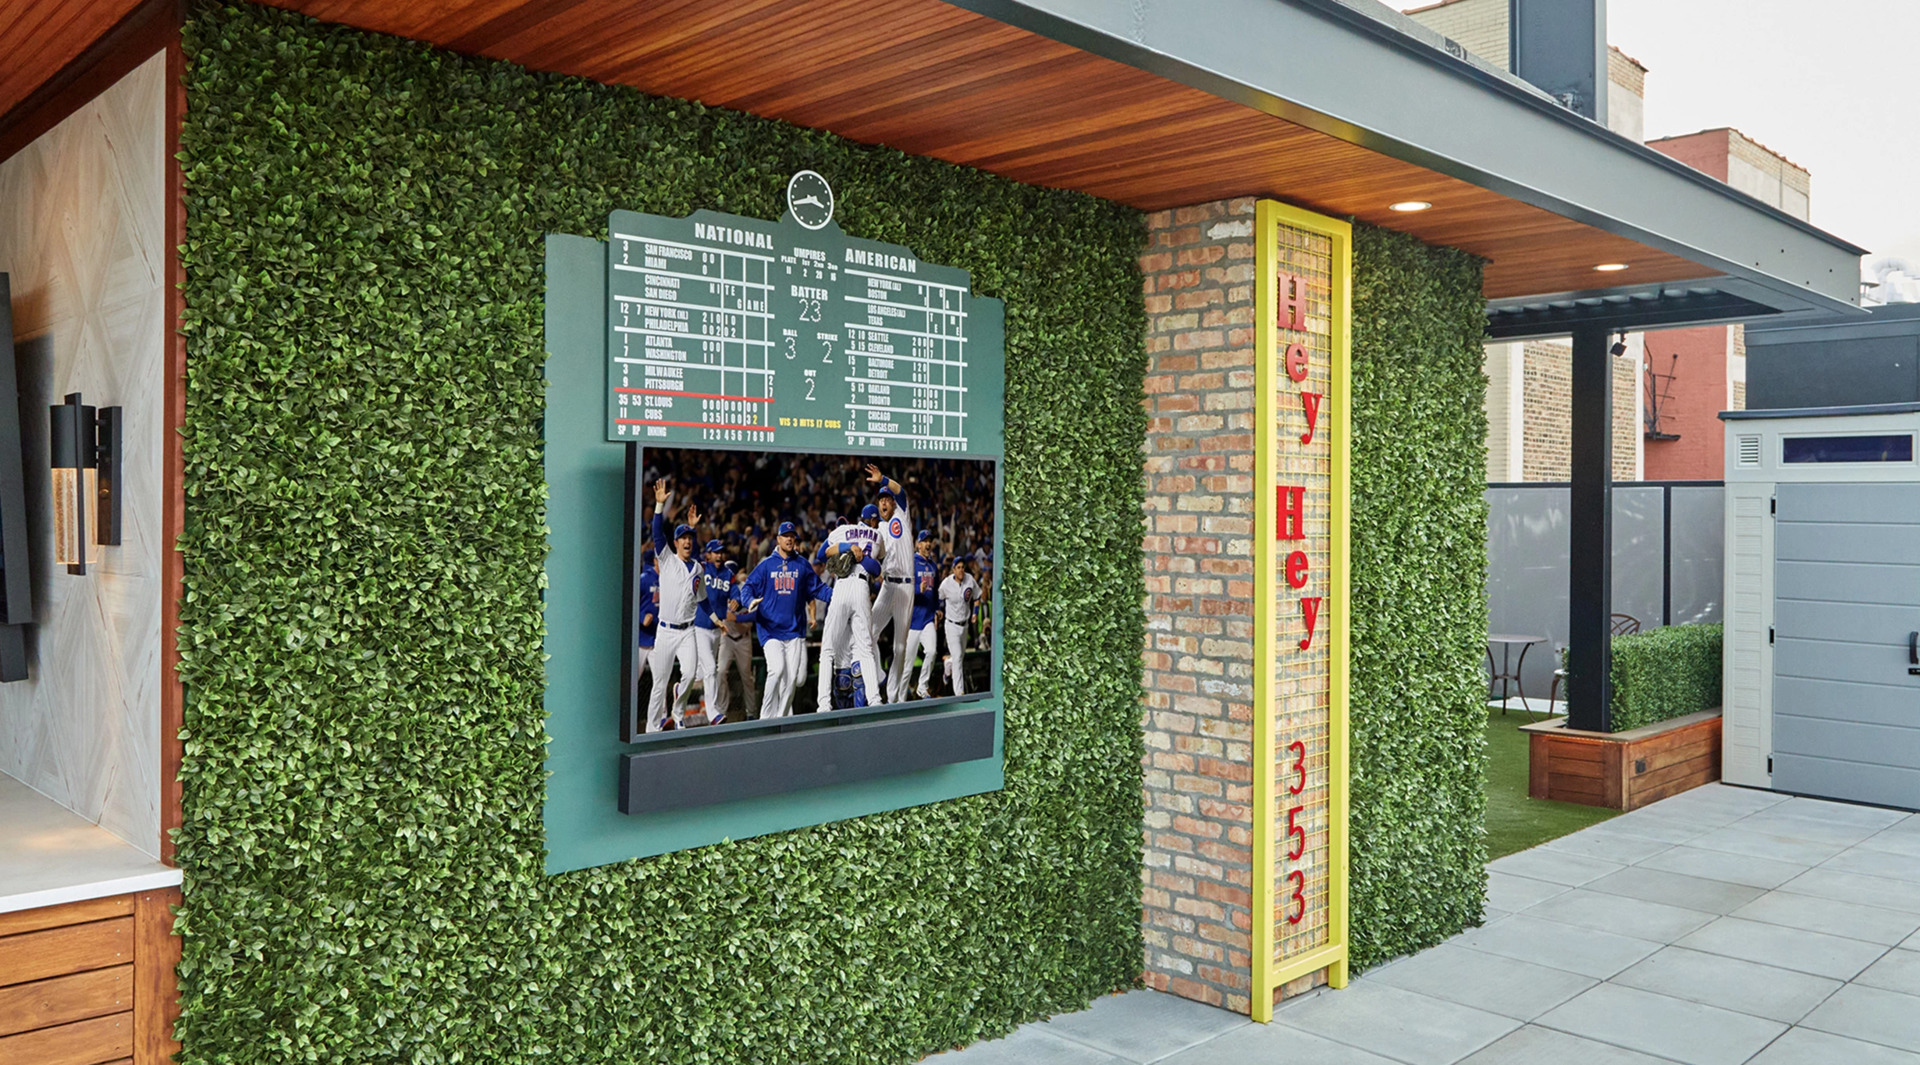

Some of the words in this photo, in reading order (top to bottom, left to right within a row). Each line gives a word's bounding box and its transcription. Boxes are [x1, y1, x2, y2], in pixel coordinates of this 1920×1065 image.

[695, 222, 774, 250] NATIONAL
[645, 244, 658, 256] SAN
[659, 245, 693, 261] FRANCISCO
[781, 255, 797, 264] PLATE
[794, 247, 826, 261] UMPIRES
[645, 256, 667, 270] MIAMI
[845, 248, 916, 273] AMERICAN
[645, 274, 680, 289] CINCINNATI
[645, 287, 658, 299] SAN
[659, 288, 677, 301] DIEGO
[791, 285, 828, 301] BATTER
[645, 305, 659, 317] NEW
[660, 307, 677, 319] YORK
[737, 299, 764, 312] GAME
[799, 299, 821, 322] 23
[645, 318, 688, 332] PHILADELPHIA
[868, 315, 883, 326] TEXAS
[645, 335, 673, 348] ATLANTA
[783, 329, 797, 337] BALL
[817, 332, 838, 341] STRIKE
[868, 331, 889, 343] SEATTLE
[645, 348, 686, 361] WASHINGTON
[785, 337, 796, 360] 3
[822, 341, 832, 363] 2
[868, 343, 894, 354] CLEVELAND
[1277, 271, 1323, 445] Hey
[645, 365, 683, 378] MILWAUKEE
[804, 369, 817, 377] OUT
[645, 378, 684, 391] PITTSBURGH
[805, 378, 816, 400] 2
[619, 394, 628, 405] 35
[632, 395, 641, 406] 53
[655, 396, 673, 408] LOUIS
[645, 408, 662, 420] CUBS
[779, 417, 791, 426] VIS
[793, 418, 798, 427] 3
[800, 418, 815, 427] HITS
[824, 420, 841, 429] CUBS
[888, 423, 899, 432] CITY
[767, 431, 774, 442] 10
[845, 528, 878, 542] CHAPMAN
[1276, 485, 1322, 650] Hey
[704, 574, 730, 592] CUBS
[1289, 741, 1306, 925] 353
